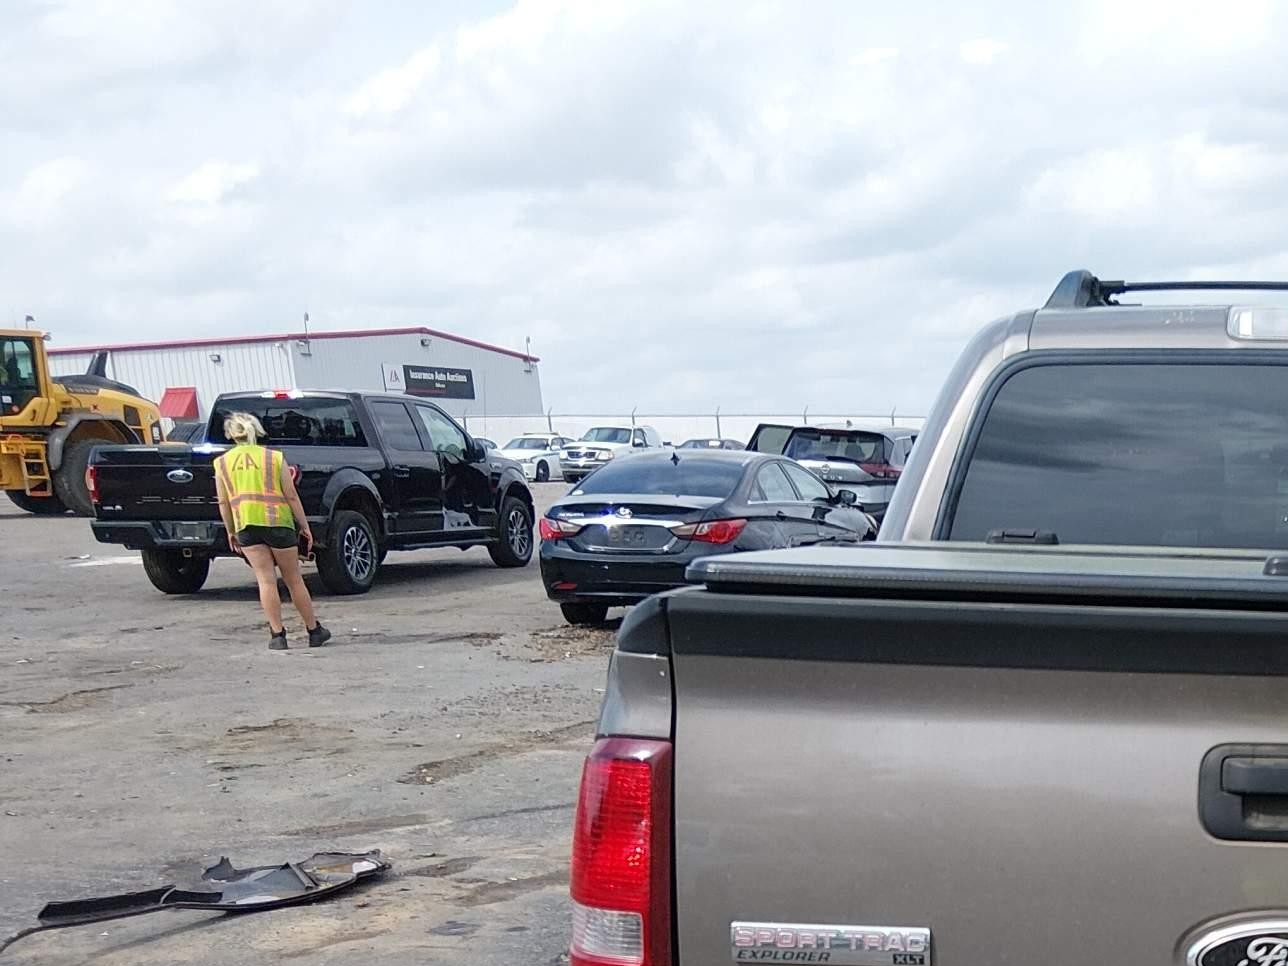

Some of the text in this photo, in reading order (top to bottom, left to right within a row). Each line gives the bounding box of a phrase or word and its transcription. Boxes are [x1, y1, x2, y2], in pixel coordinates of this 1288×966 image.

[409, 369, 467, 383] Insurance Auto Auctions
[735, 926, 928, 952] SPORT TRAC
[737, 950, 925, 965] EXPLORER XLT
